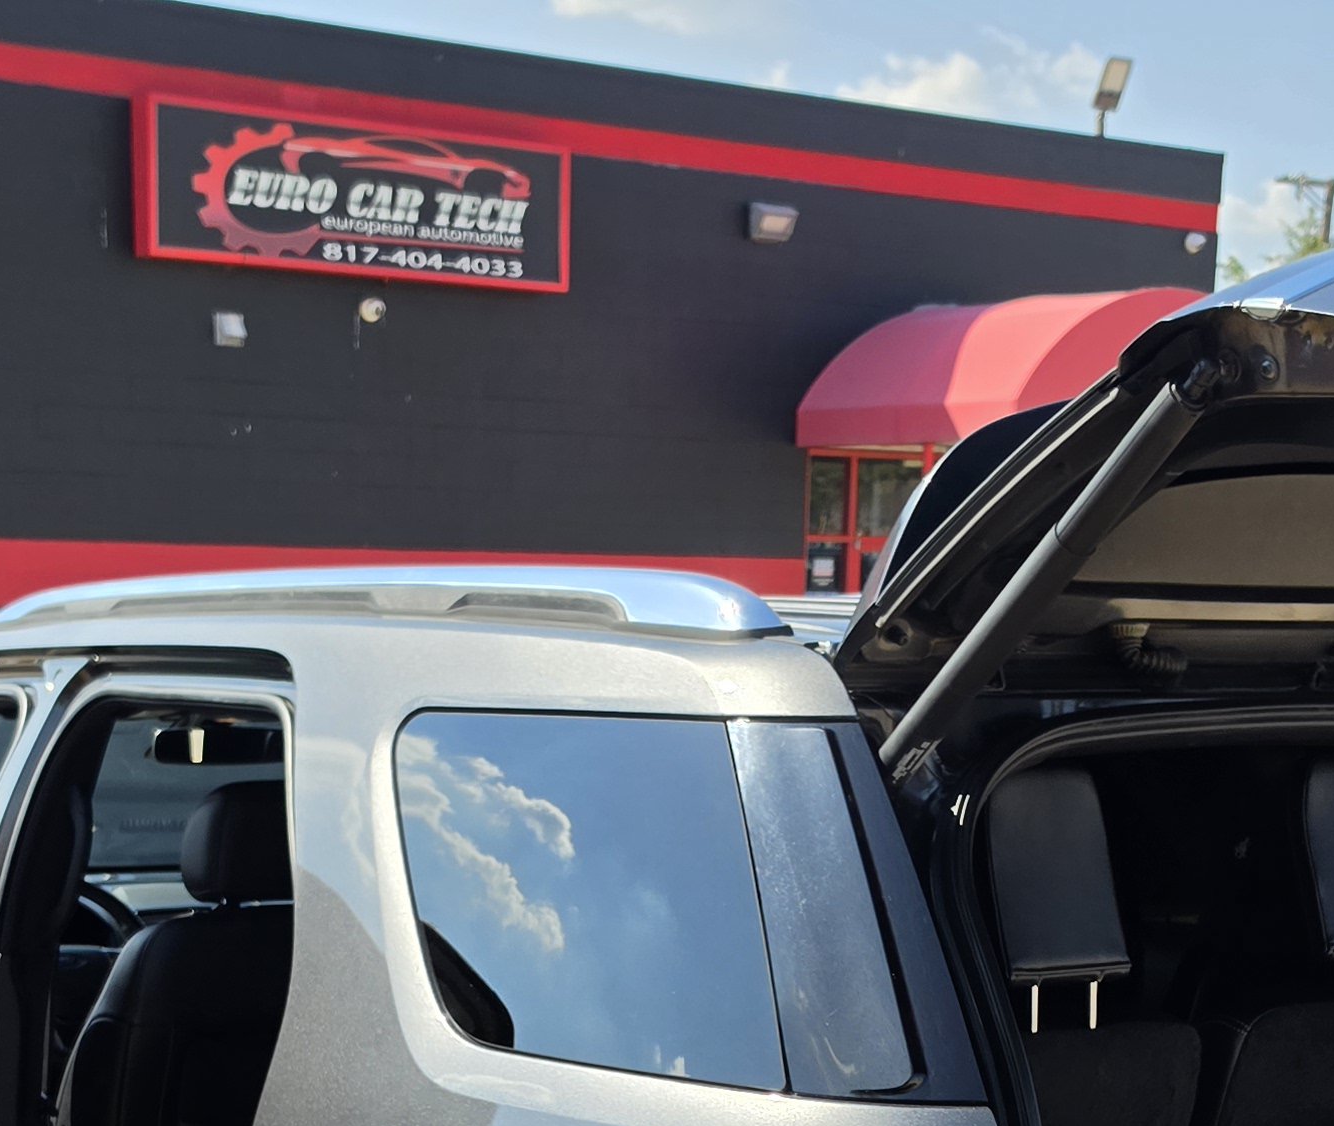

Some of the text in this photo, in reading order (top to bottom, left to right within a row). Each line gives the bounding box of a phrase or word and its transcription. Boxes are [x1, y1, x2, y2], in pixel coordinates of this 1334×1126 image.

[227, 167, 530, 234] EURO CAR TECH
[320, 214, 524, 249] european automotive
[321, 242, 524, 279] 817-404-4033
